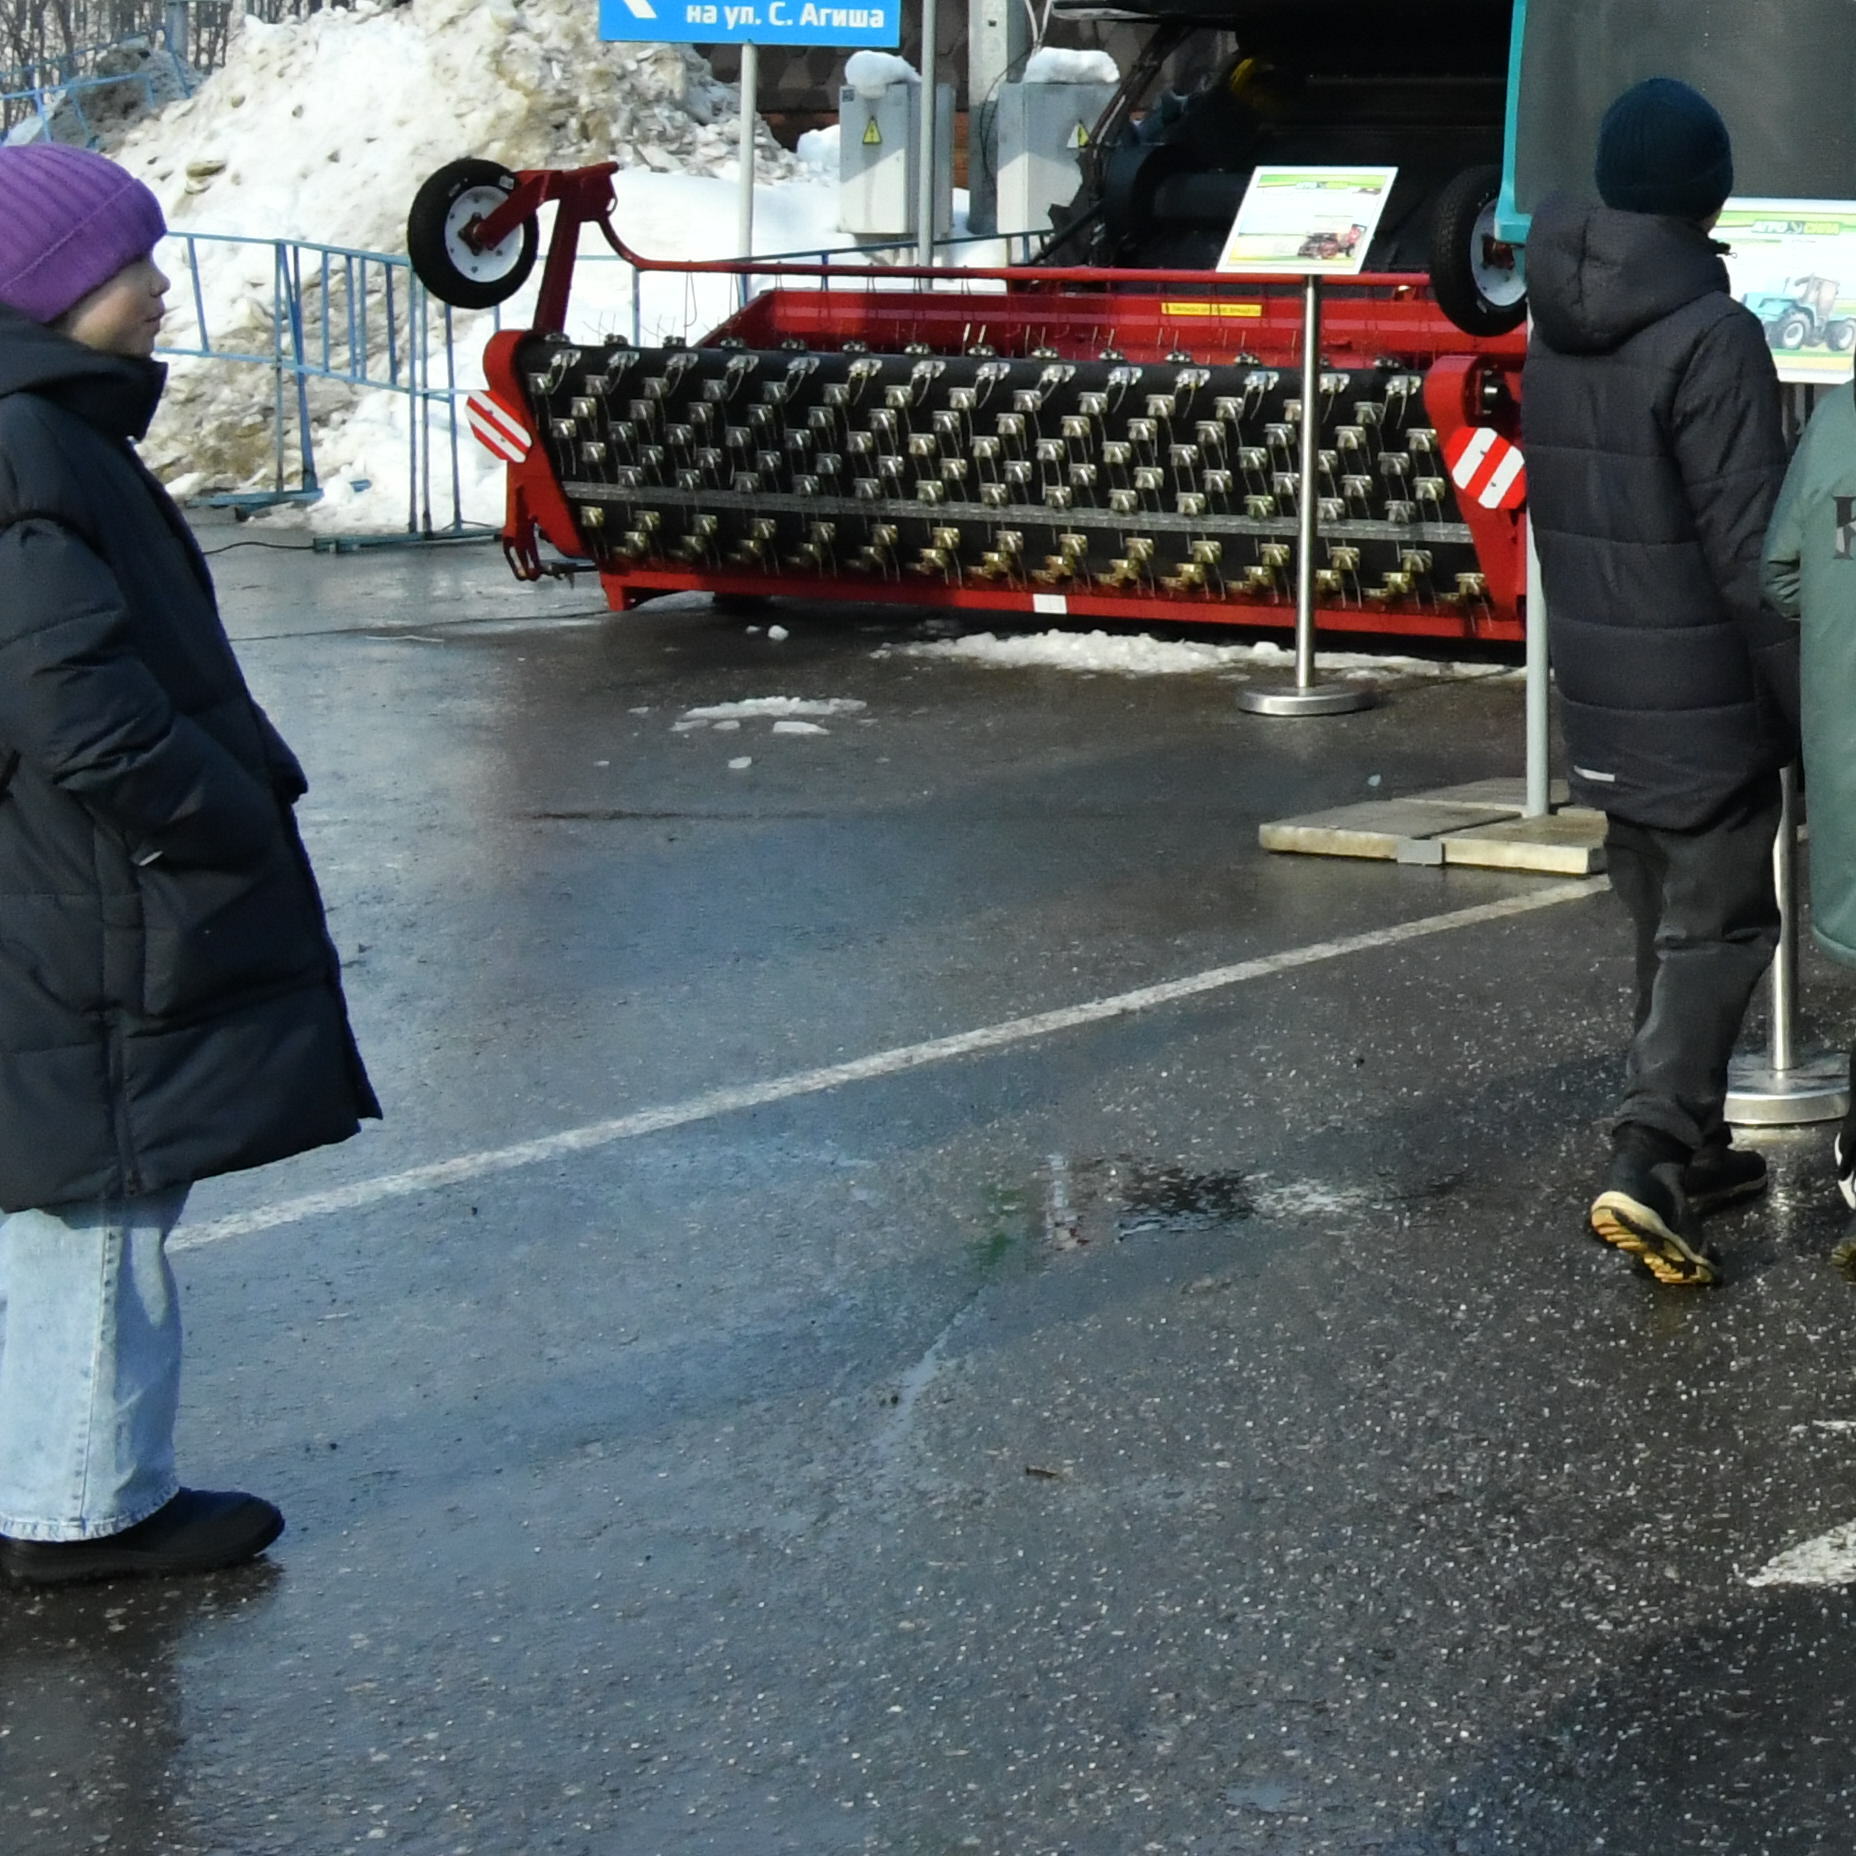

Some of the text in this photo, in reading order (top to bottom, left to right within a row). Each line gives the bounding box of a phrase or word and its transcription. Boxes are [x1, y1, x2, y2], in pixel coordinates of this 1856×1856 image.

[686, 1, 885, 30] на ул. С. Агиша
